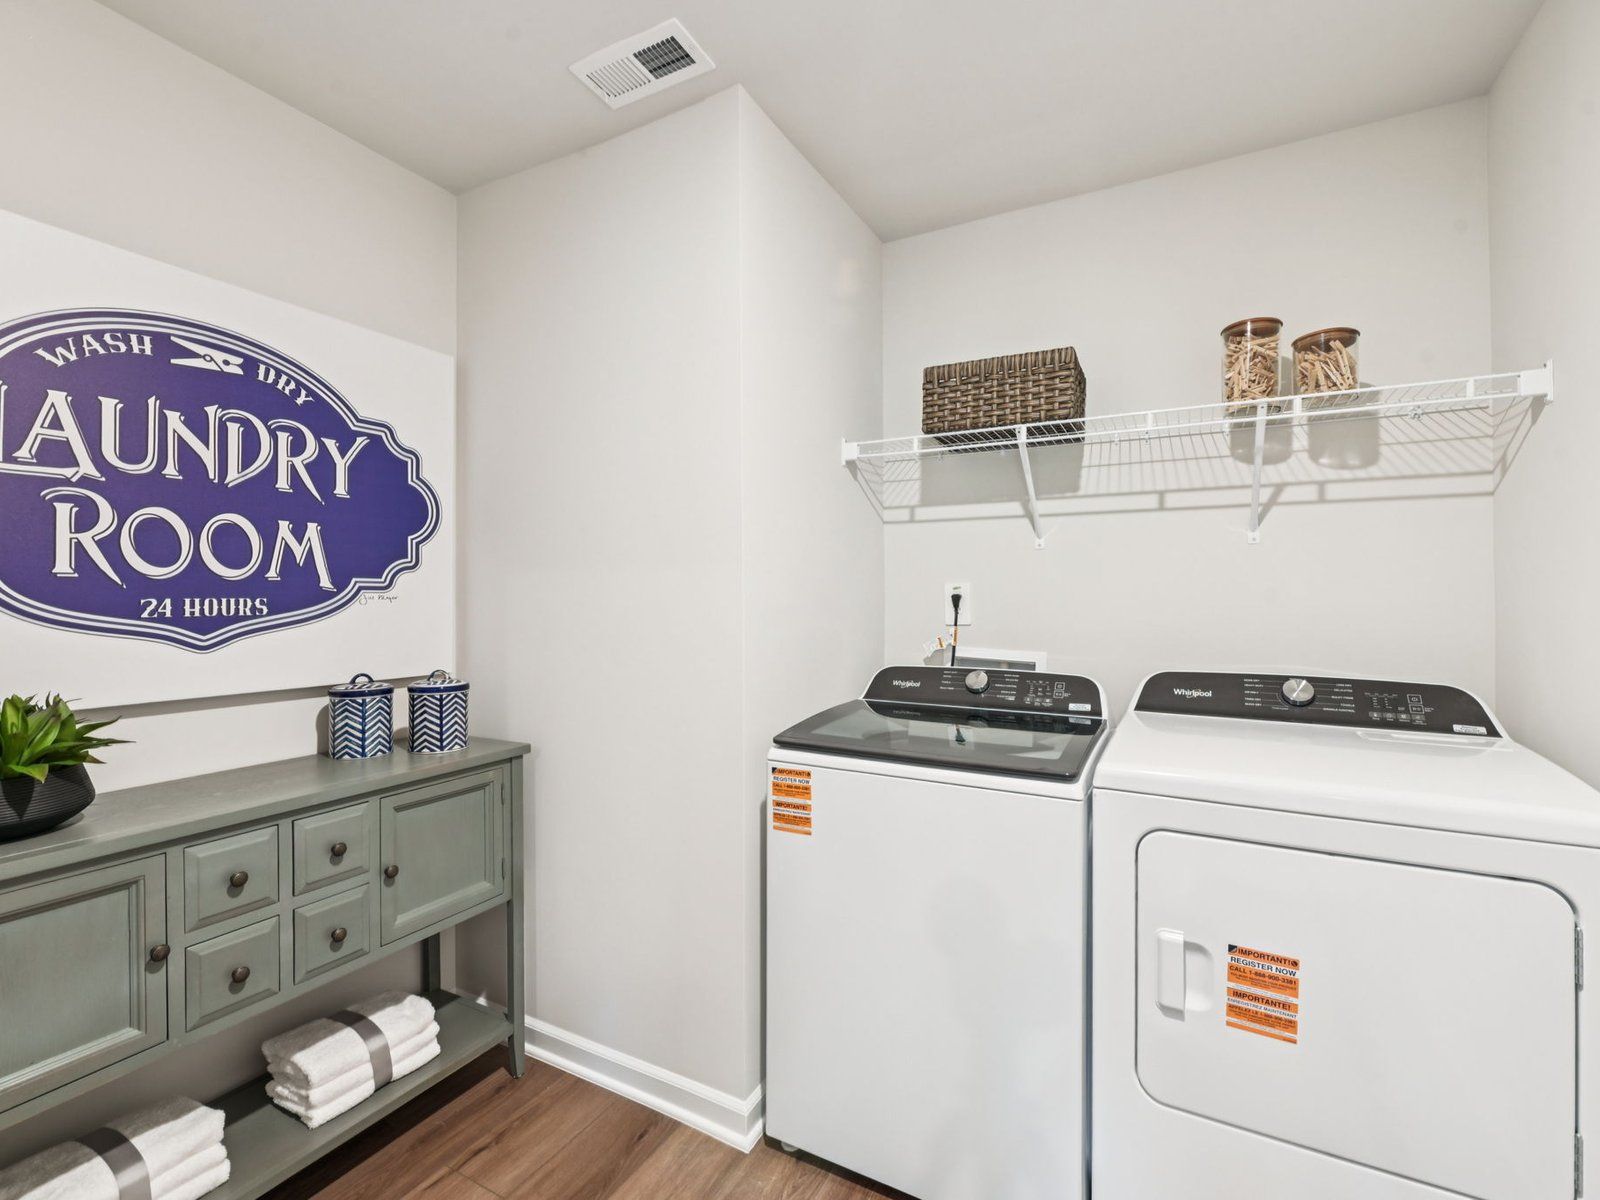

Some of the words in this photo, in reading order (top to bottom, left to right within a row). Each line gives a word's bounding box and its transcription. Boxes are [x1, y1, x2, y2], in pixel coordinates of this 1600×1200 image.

[33, 332, 153, 367] WASH
[256, 362, 315, 405] DRY
[40, 487, 337, 591] ROOM
[140, 598, 172, 618] 24
[183, 597, 268, 617] HOURS
[892, 679, 921, 689] Whirlpool
[1173, 687, 1213, 699] Whirlpool
[1230, 956, 1273, 972] REGISTER
[1275, 967, 1297, 977] NOW
[1238, 948, 1291, 966] IMPORTANT!
[1229, 965, 1247, 974] CALL
[1232, 990, 1292, 1011] IMPORTANTE!
